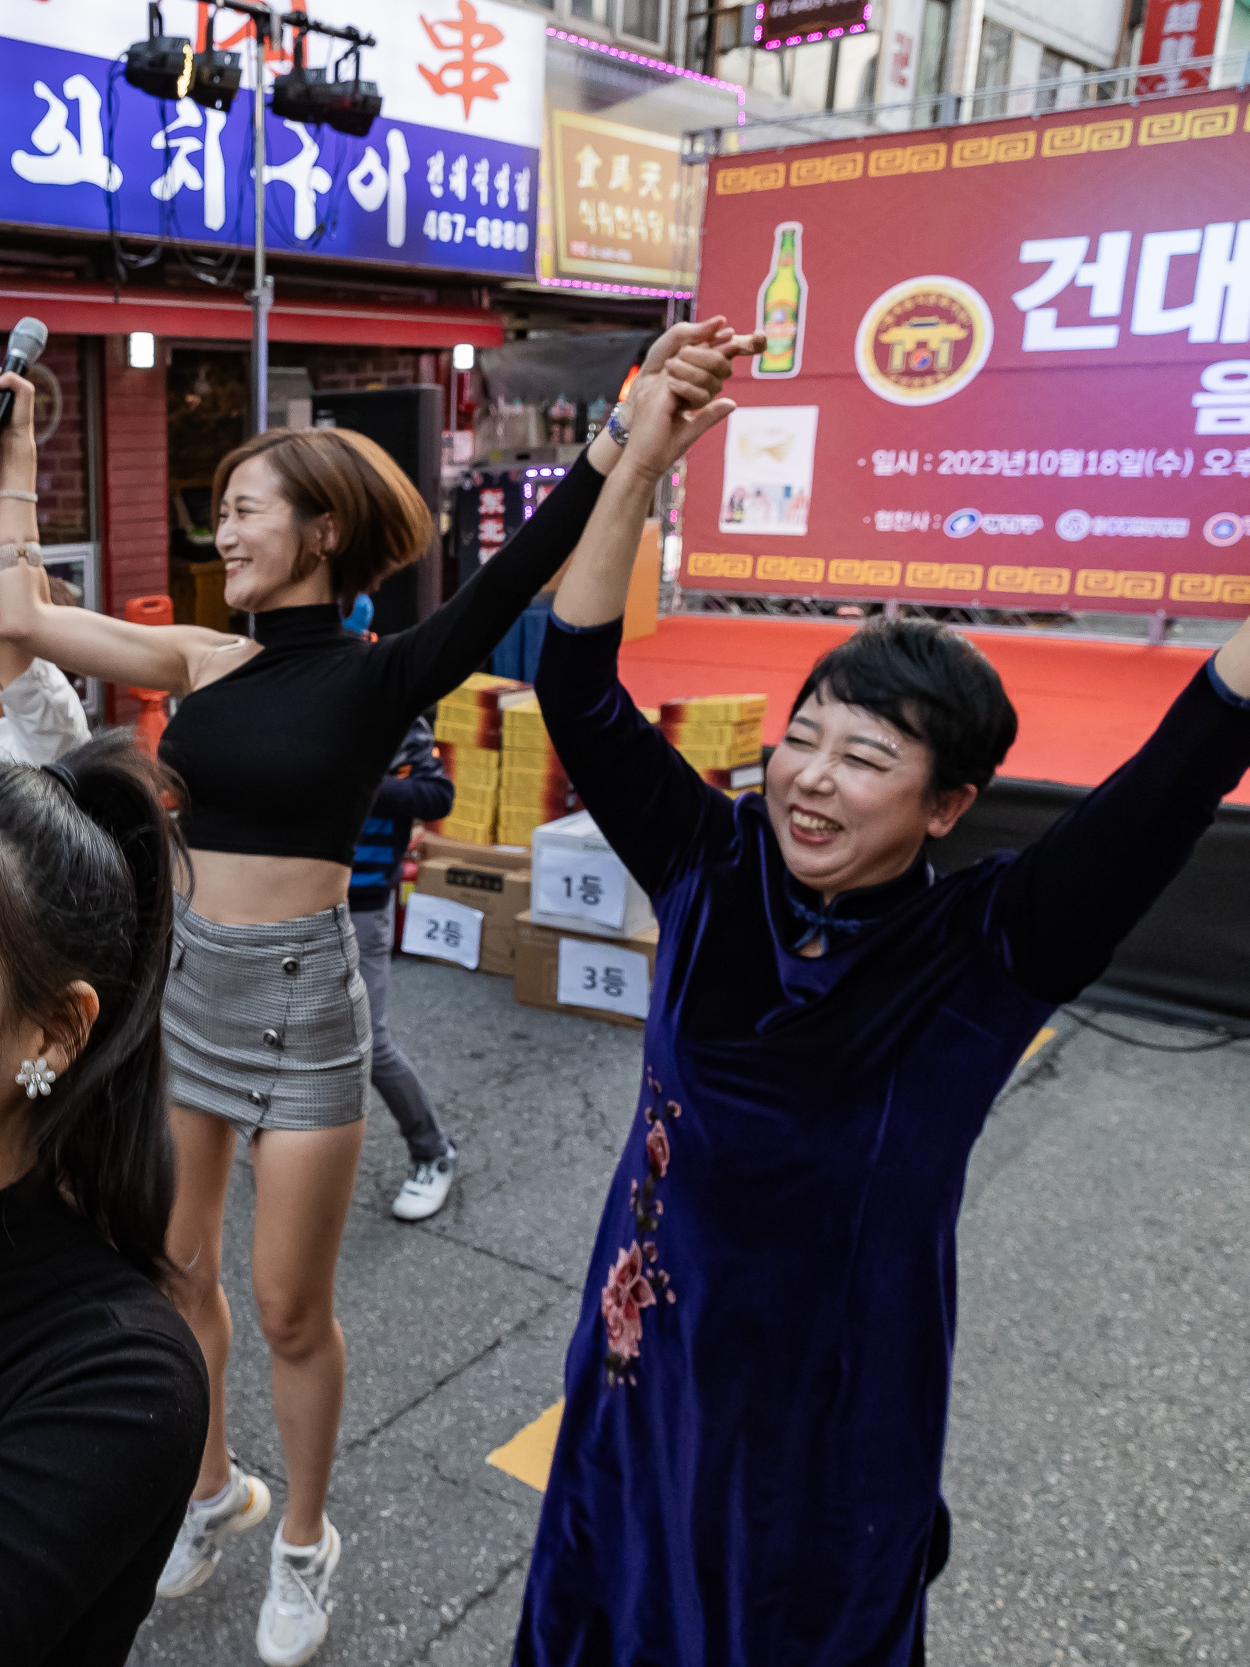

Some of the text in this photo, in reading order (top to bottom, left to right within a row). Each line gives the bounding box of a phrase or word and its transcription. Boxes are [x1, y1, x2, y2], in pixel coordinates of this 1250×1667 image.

[1011, 218, 1250, 353] 건대
[561, 874, 606, 906] 1등
[425, 918, 463, 949] 2등
[582, 965, 627, 997] 3등
